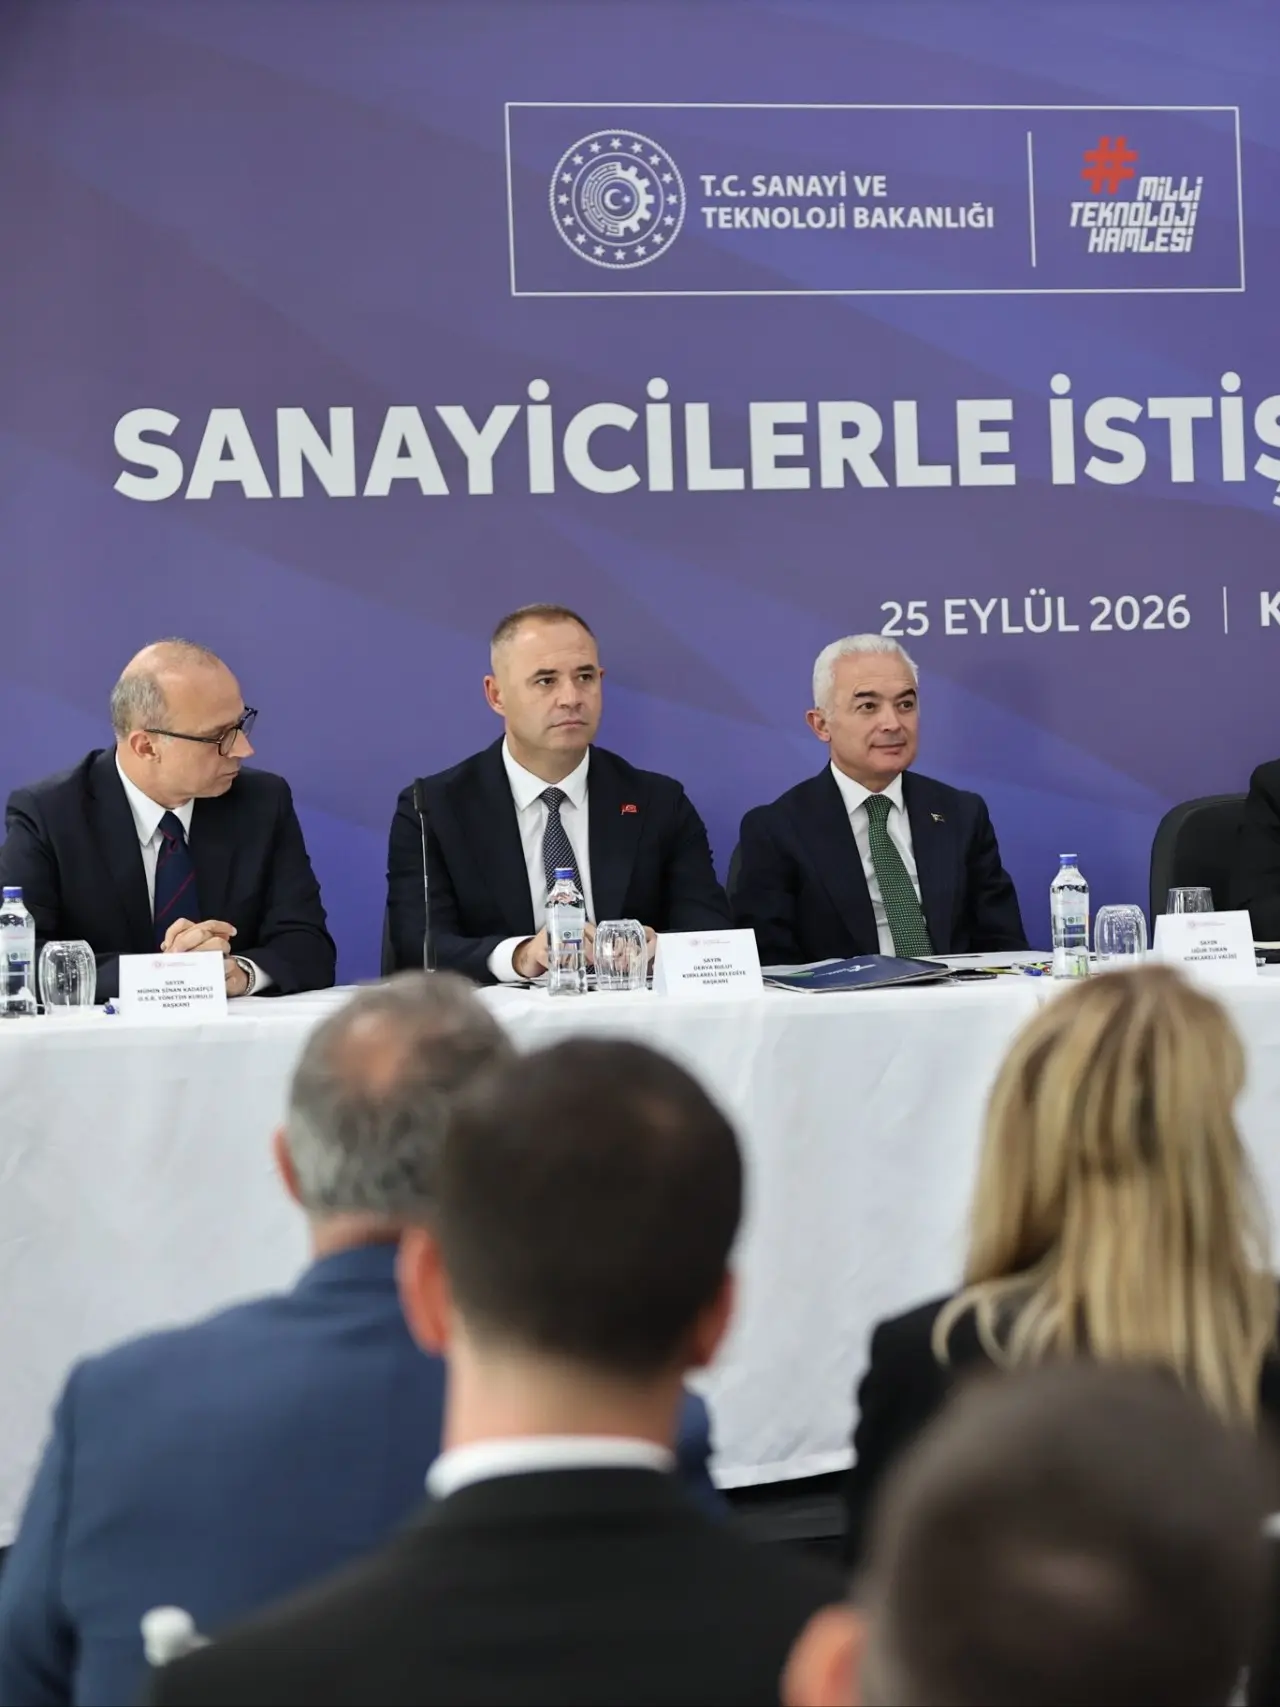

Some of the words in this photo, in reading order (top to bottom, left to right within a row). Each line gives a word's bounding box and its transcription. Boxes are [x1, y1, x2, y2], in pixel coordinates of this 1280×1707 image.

[700, 175, 746, 197] T.C.
[752, 170, 847, 197] SANAYİ
[853, 175, 888, 196] VE
[701, 203, 846, 229] TEKNOLOJİ
[853, 203, 994, 228] BAKANLIĞI
[113, 377, 1017, 503] SANAYİCİLERLE
[879, 600, 930, 636] 25
[944, 588, 1080, 635] EYLÜL
[1089, 594, 1191, 632] 2026
